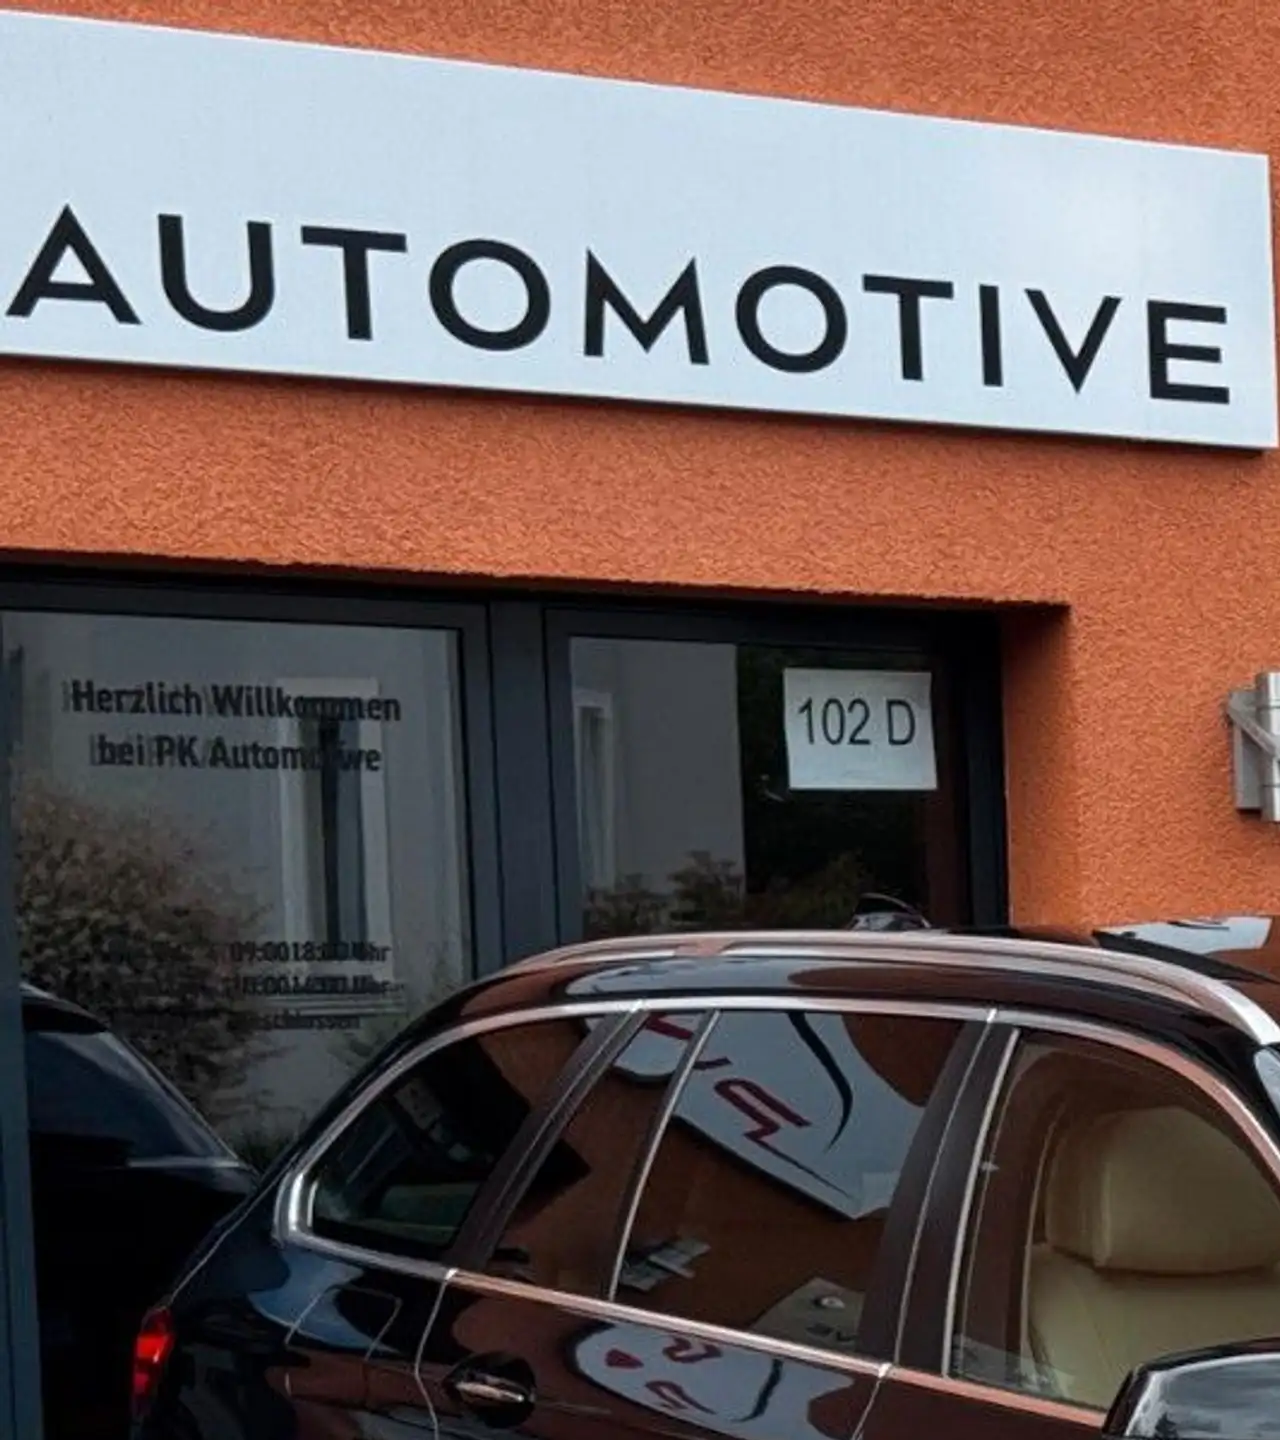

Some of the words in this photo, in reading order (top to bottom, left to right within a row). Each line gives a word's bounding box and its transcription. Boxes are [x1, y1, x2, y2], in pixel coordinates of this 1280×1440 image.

[5, 203, 1231, 406] AUTOMOTIVE
[72, 679, 203, 715] Herzlich
[798, 697, 872, 746] 102
[886, 698, 916, 746] D
[97, 733, 145, 766] bei
[155, 734, 198, 767] PK
[208, 736, 381, 772] Automoive
